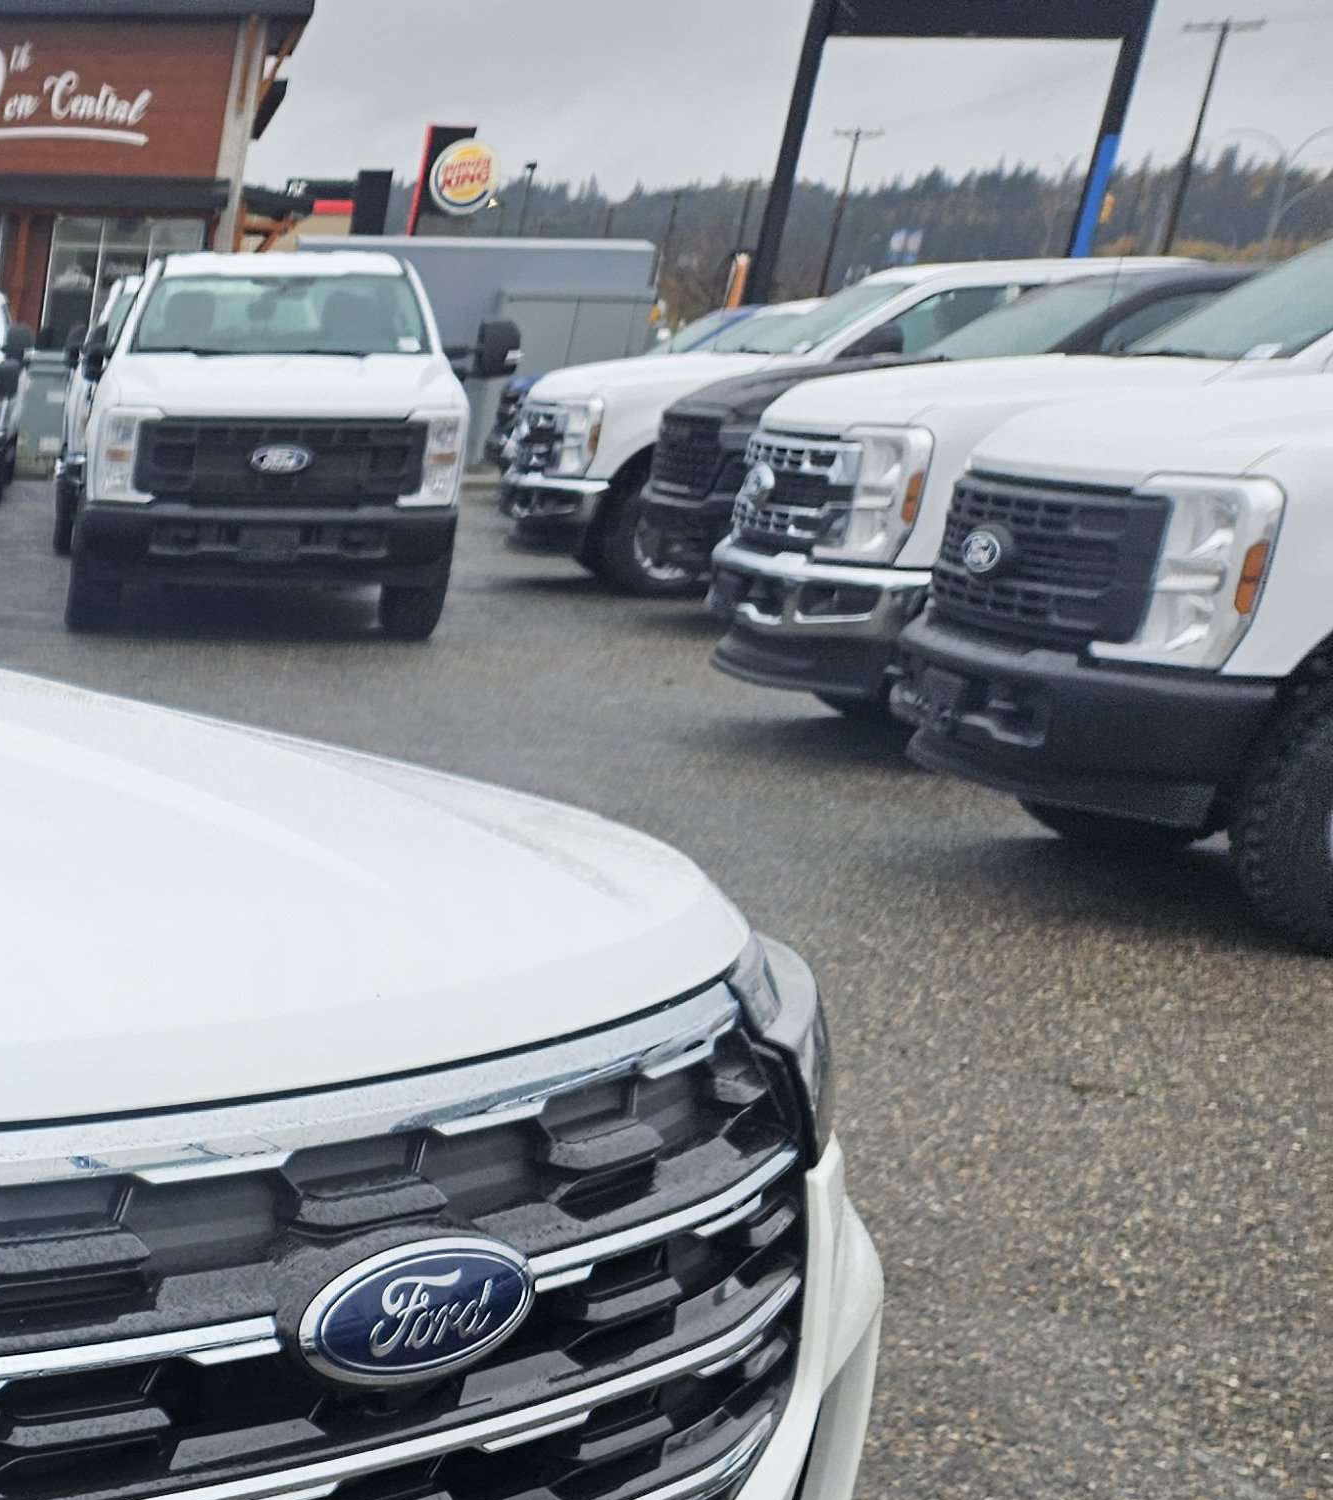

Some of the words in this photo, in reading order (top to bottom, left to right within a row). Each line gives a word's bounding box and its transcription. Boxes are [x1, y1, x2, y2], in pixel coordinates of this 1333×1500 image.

[43, 70, 152, 126] Central
[439, 170, 490, 192] KING
[369, 1266, 493, 1357] Ford
